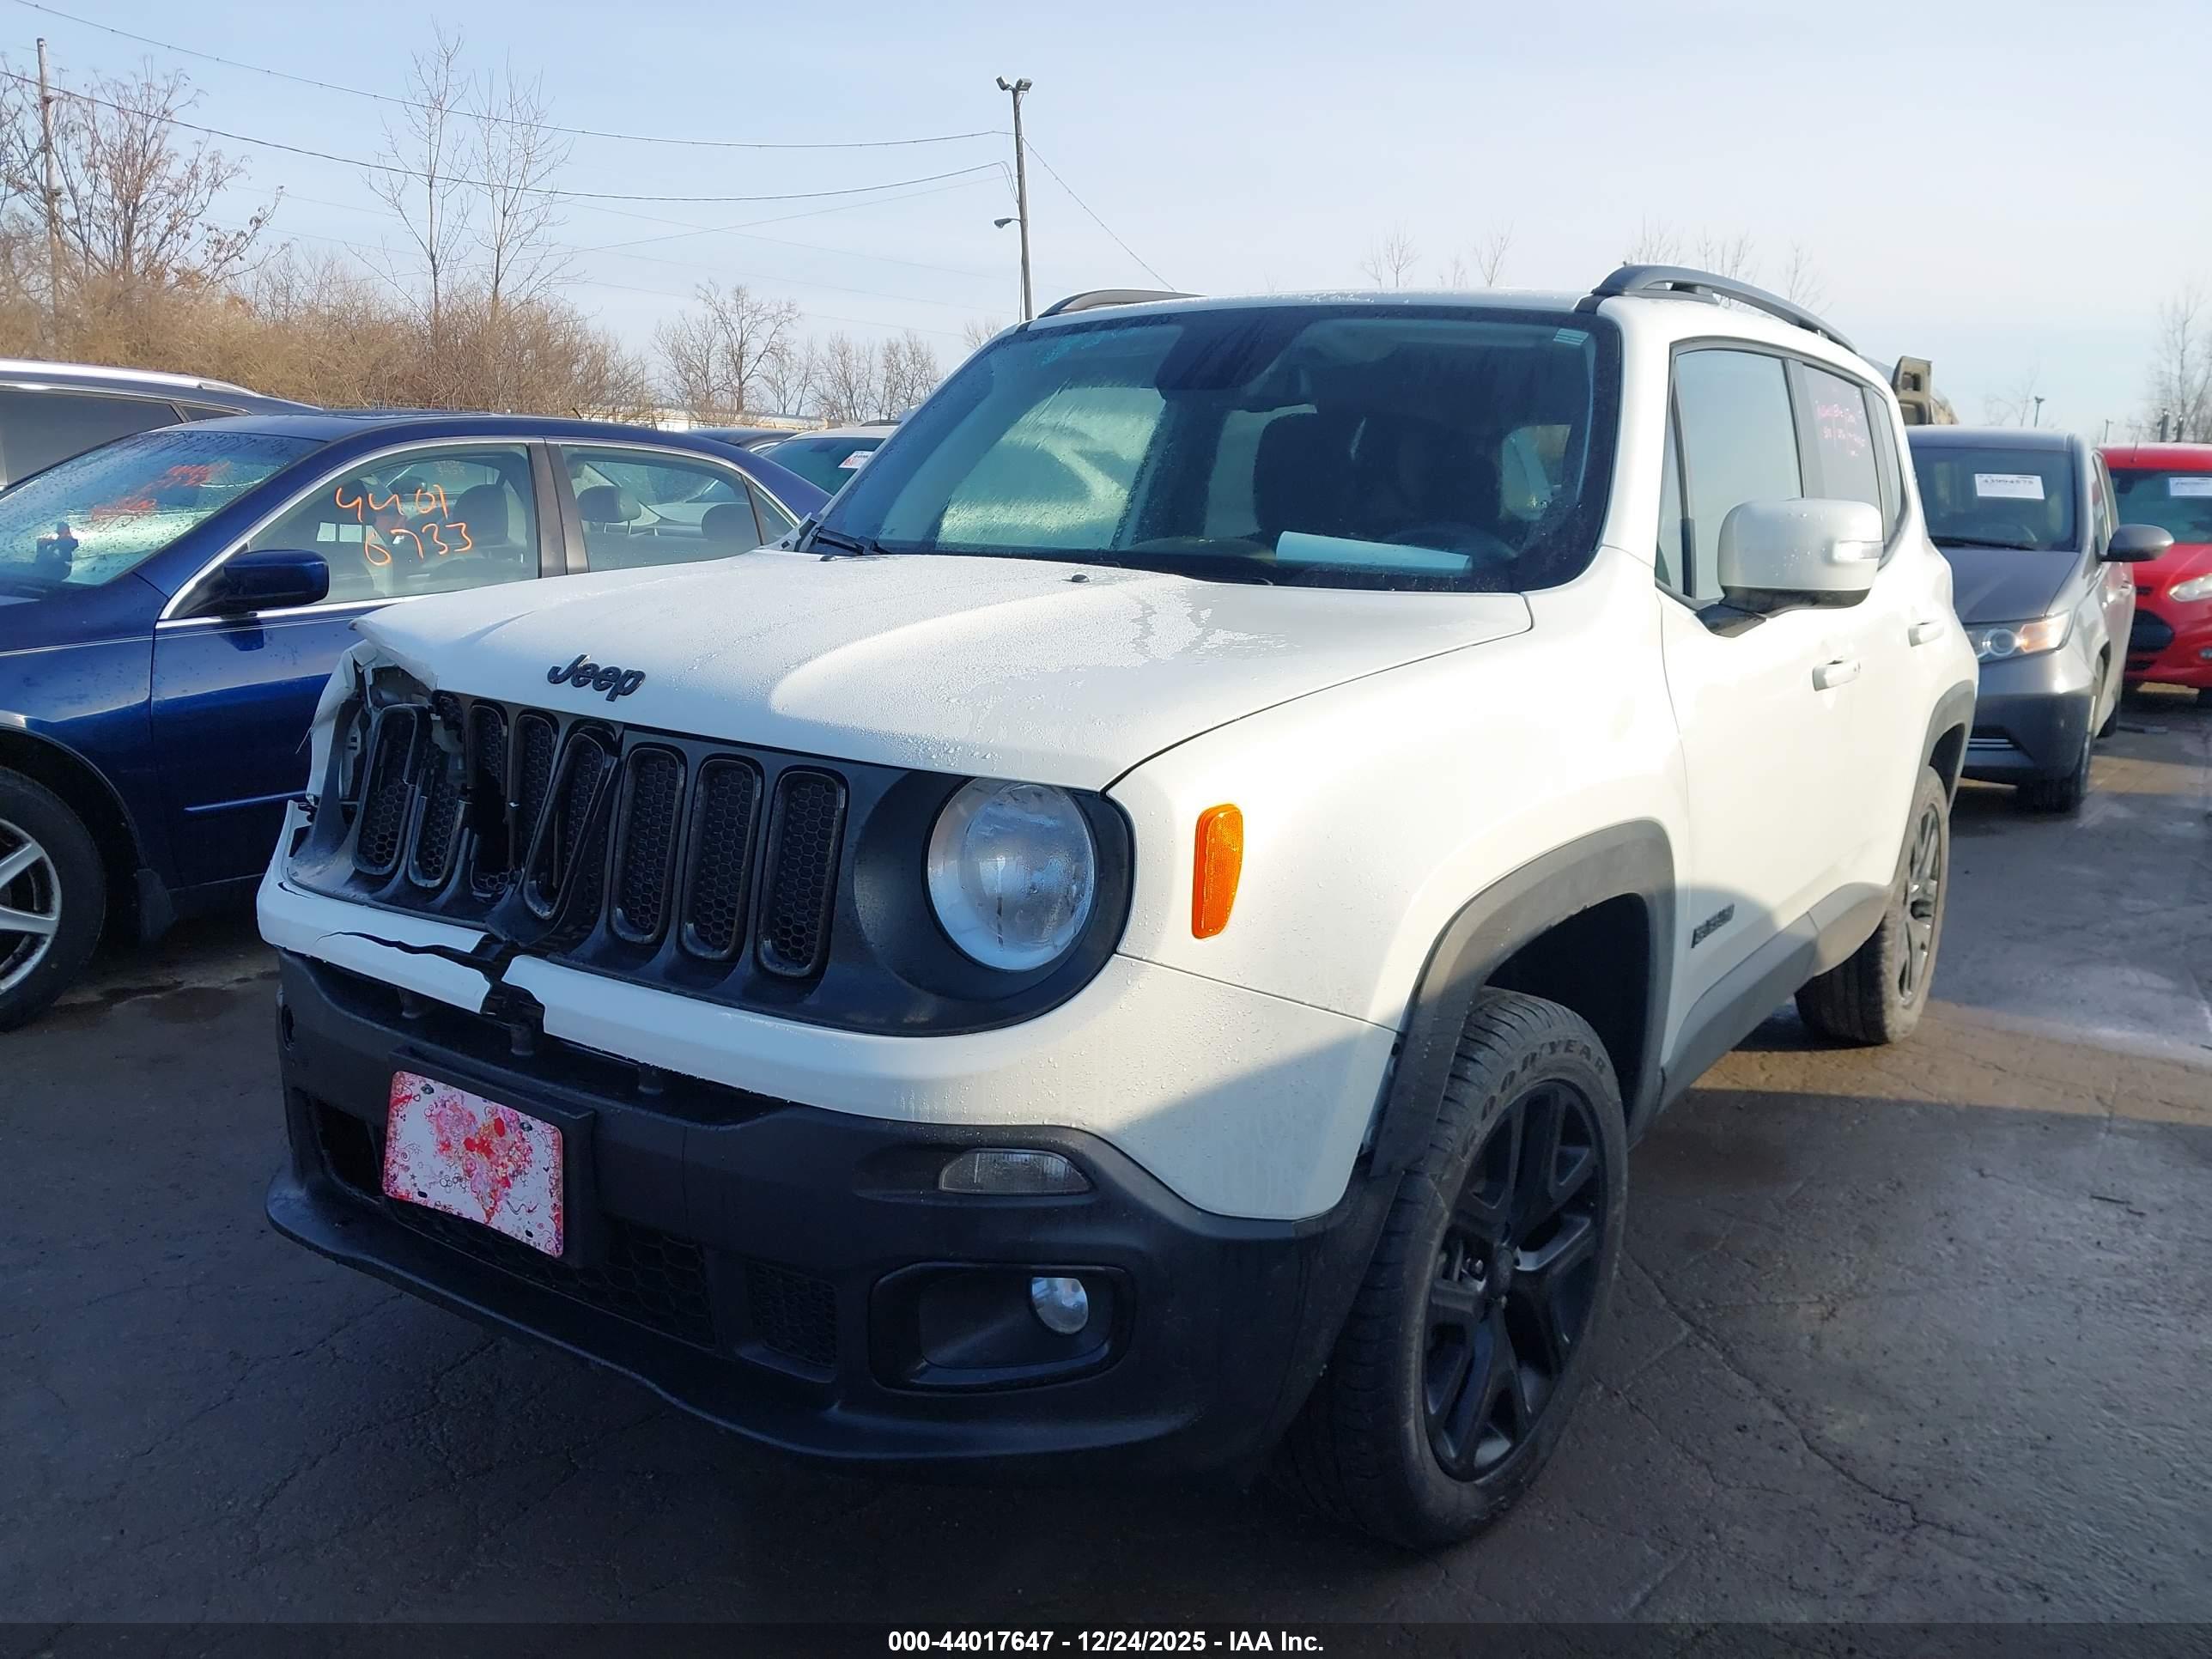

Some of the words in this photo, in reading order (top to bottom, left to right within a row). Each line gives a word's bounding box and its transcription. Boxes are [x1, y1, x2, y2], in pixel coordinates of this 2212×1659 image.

[336, 483, 449, 523] 4401
[364, 522, 473, 566] 6733
[547, 653, 646, 702] Jeep
